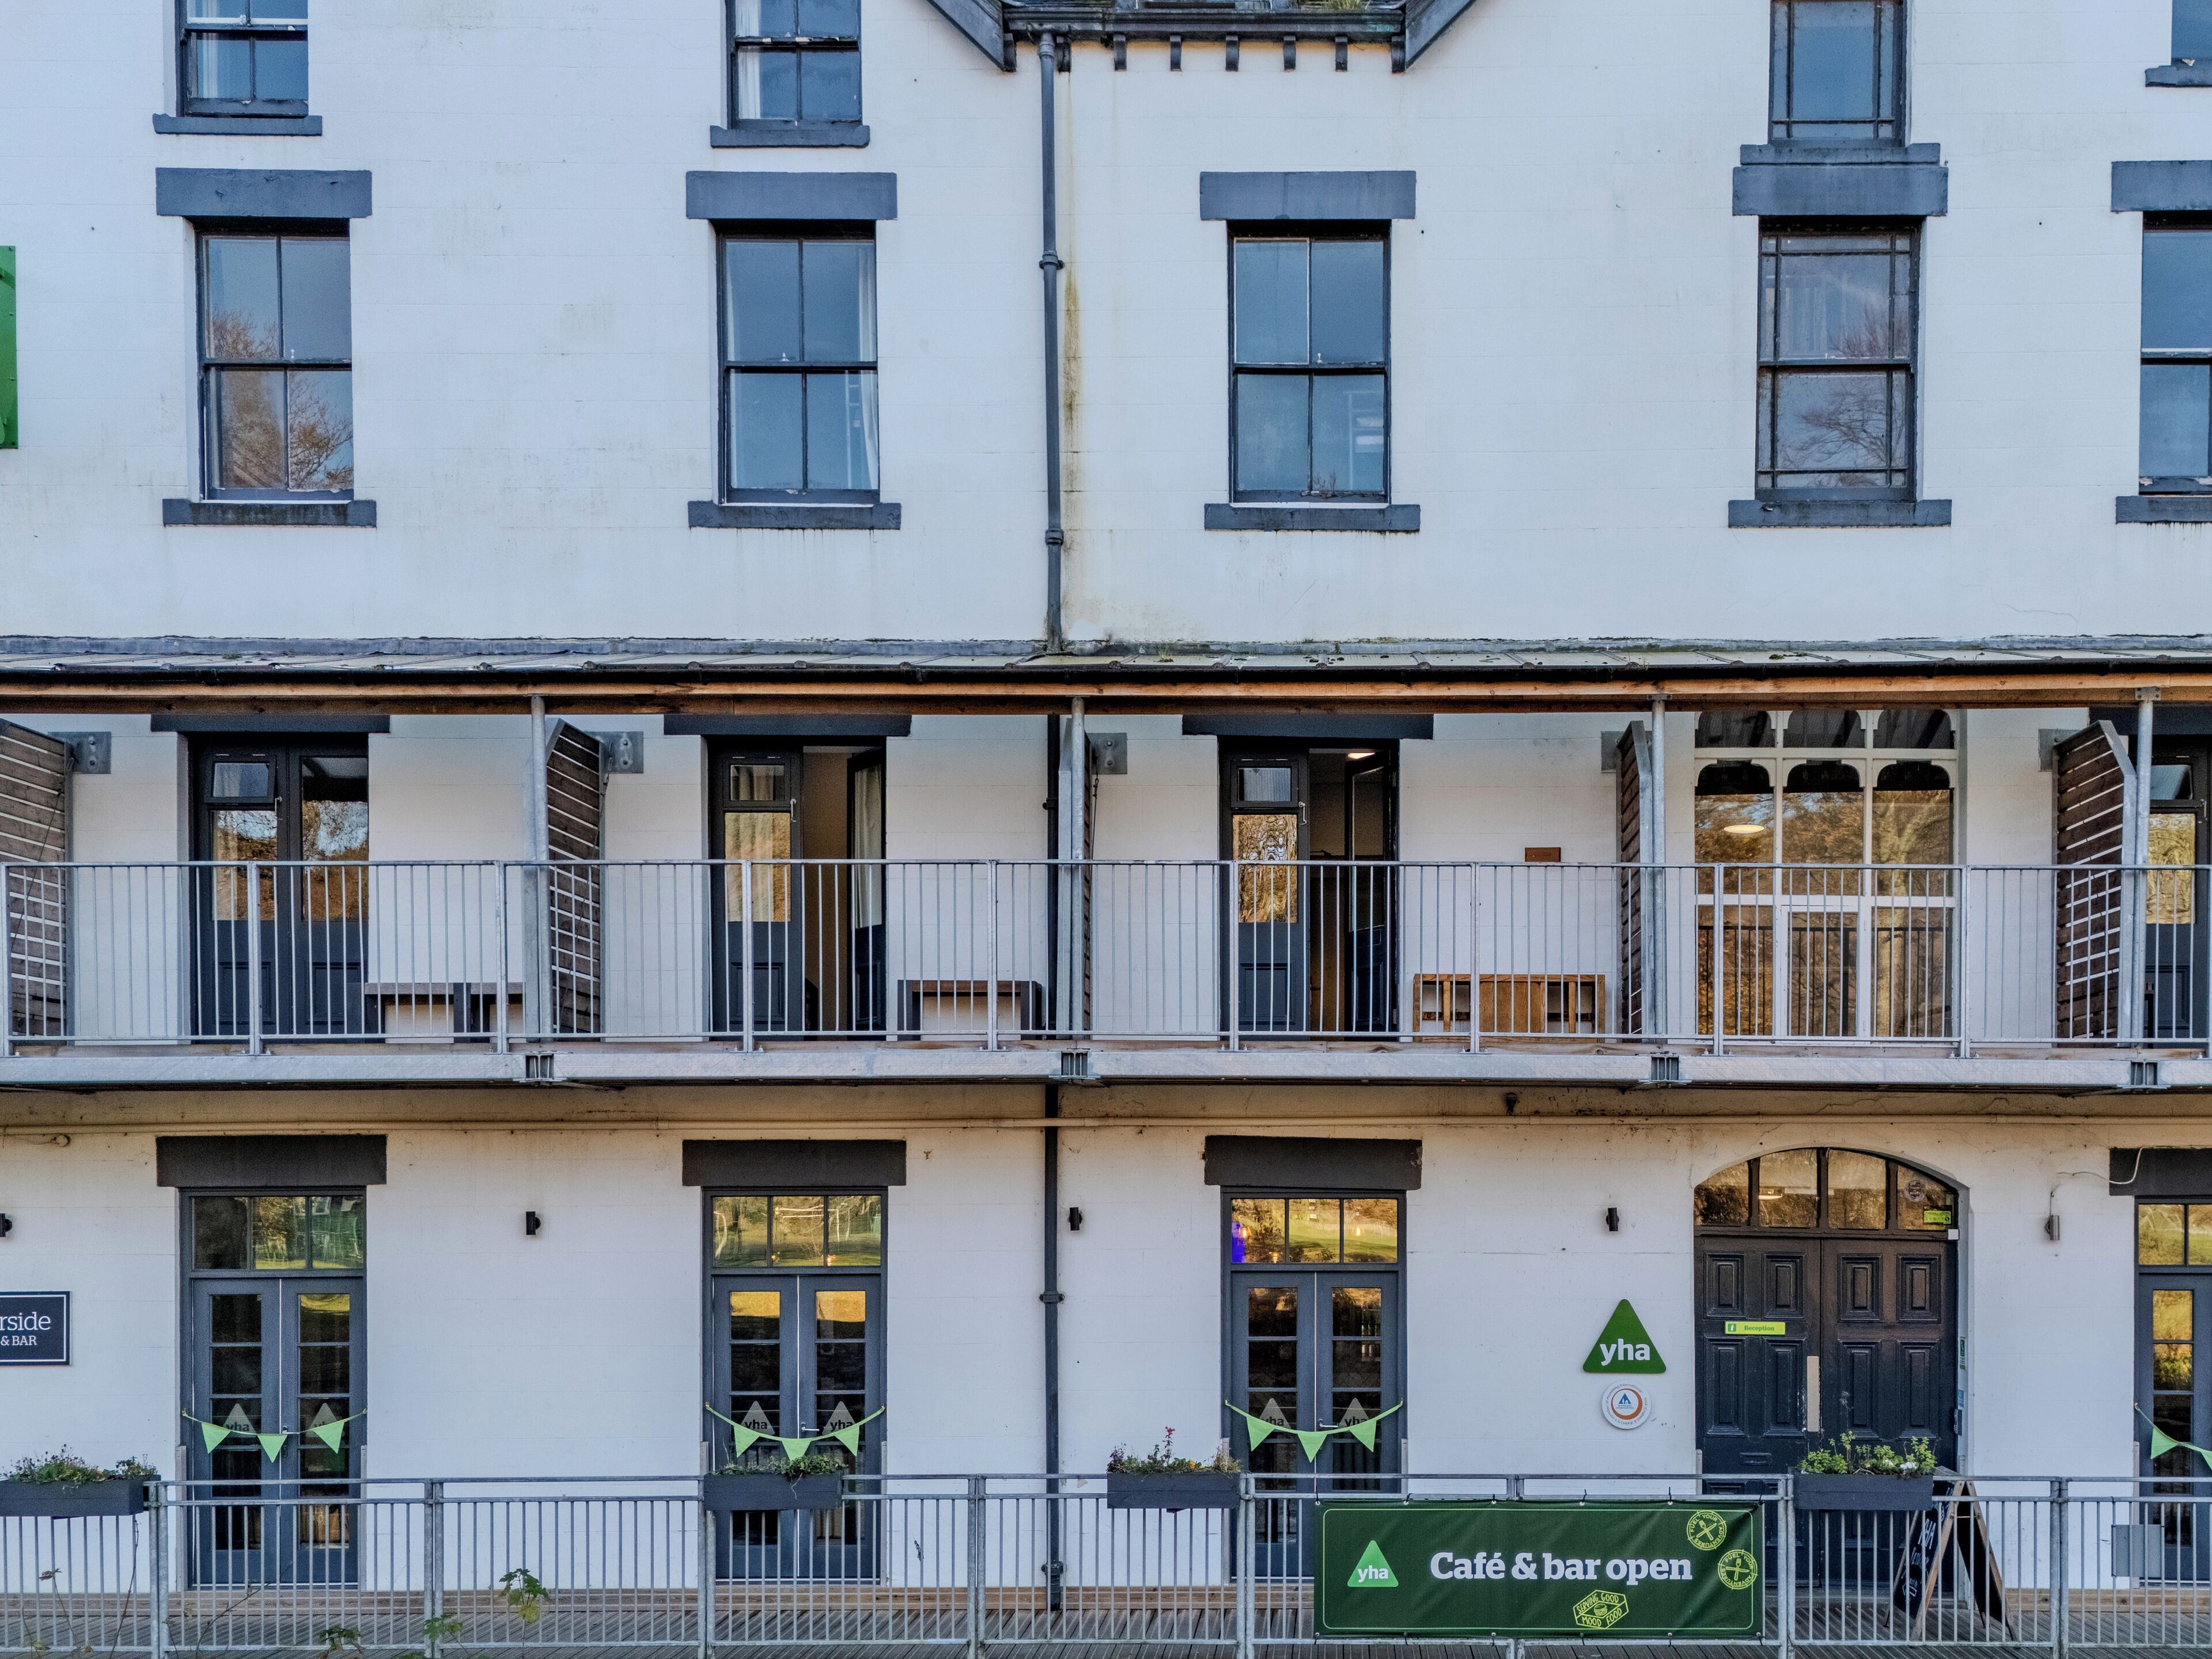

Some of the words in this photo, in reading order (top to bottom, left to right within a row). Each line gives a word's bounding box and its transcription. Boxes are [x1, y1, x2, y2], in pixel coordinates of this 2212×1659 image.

[1, 1336, 10, 1346] &
[12, 1336, 37, 1346] BAR
[1600, 1338, 1650, 1366] yha
[1690, 1518, 1700, 1532] FUEL
[1694, 1527, 1723, 1547] ADVENTURES
[1431, 1552, 1505, 1580] Café
[1512, 1552, 1537, 1580] &
[1542, 1552, 1601, 1580] bar
[1606, 1559, 1692, 1585] open
[1725, 1554, 1740, 1562] FUEL
[1744, 1555, 1753, 1569] YOUR
[1358, 1565, 1388, 1583] yha
[1577, 1593, 1599, 1615] SERVING
[1601, 1593, 1619, 1603] GOOD
[1582, 1616, 1601, 1627] MOOD
[1605, 1608, 1622, 1625] FOOD
